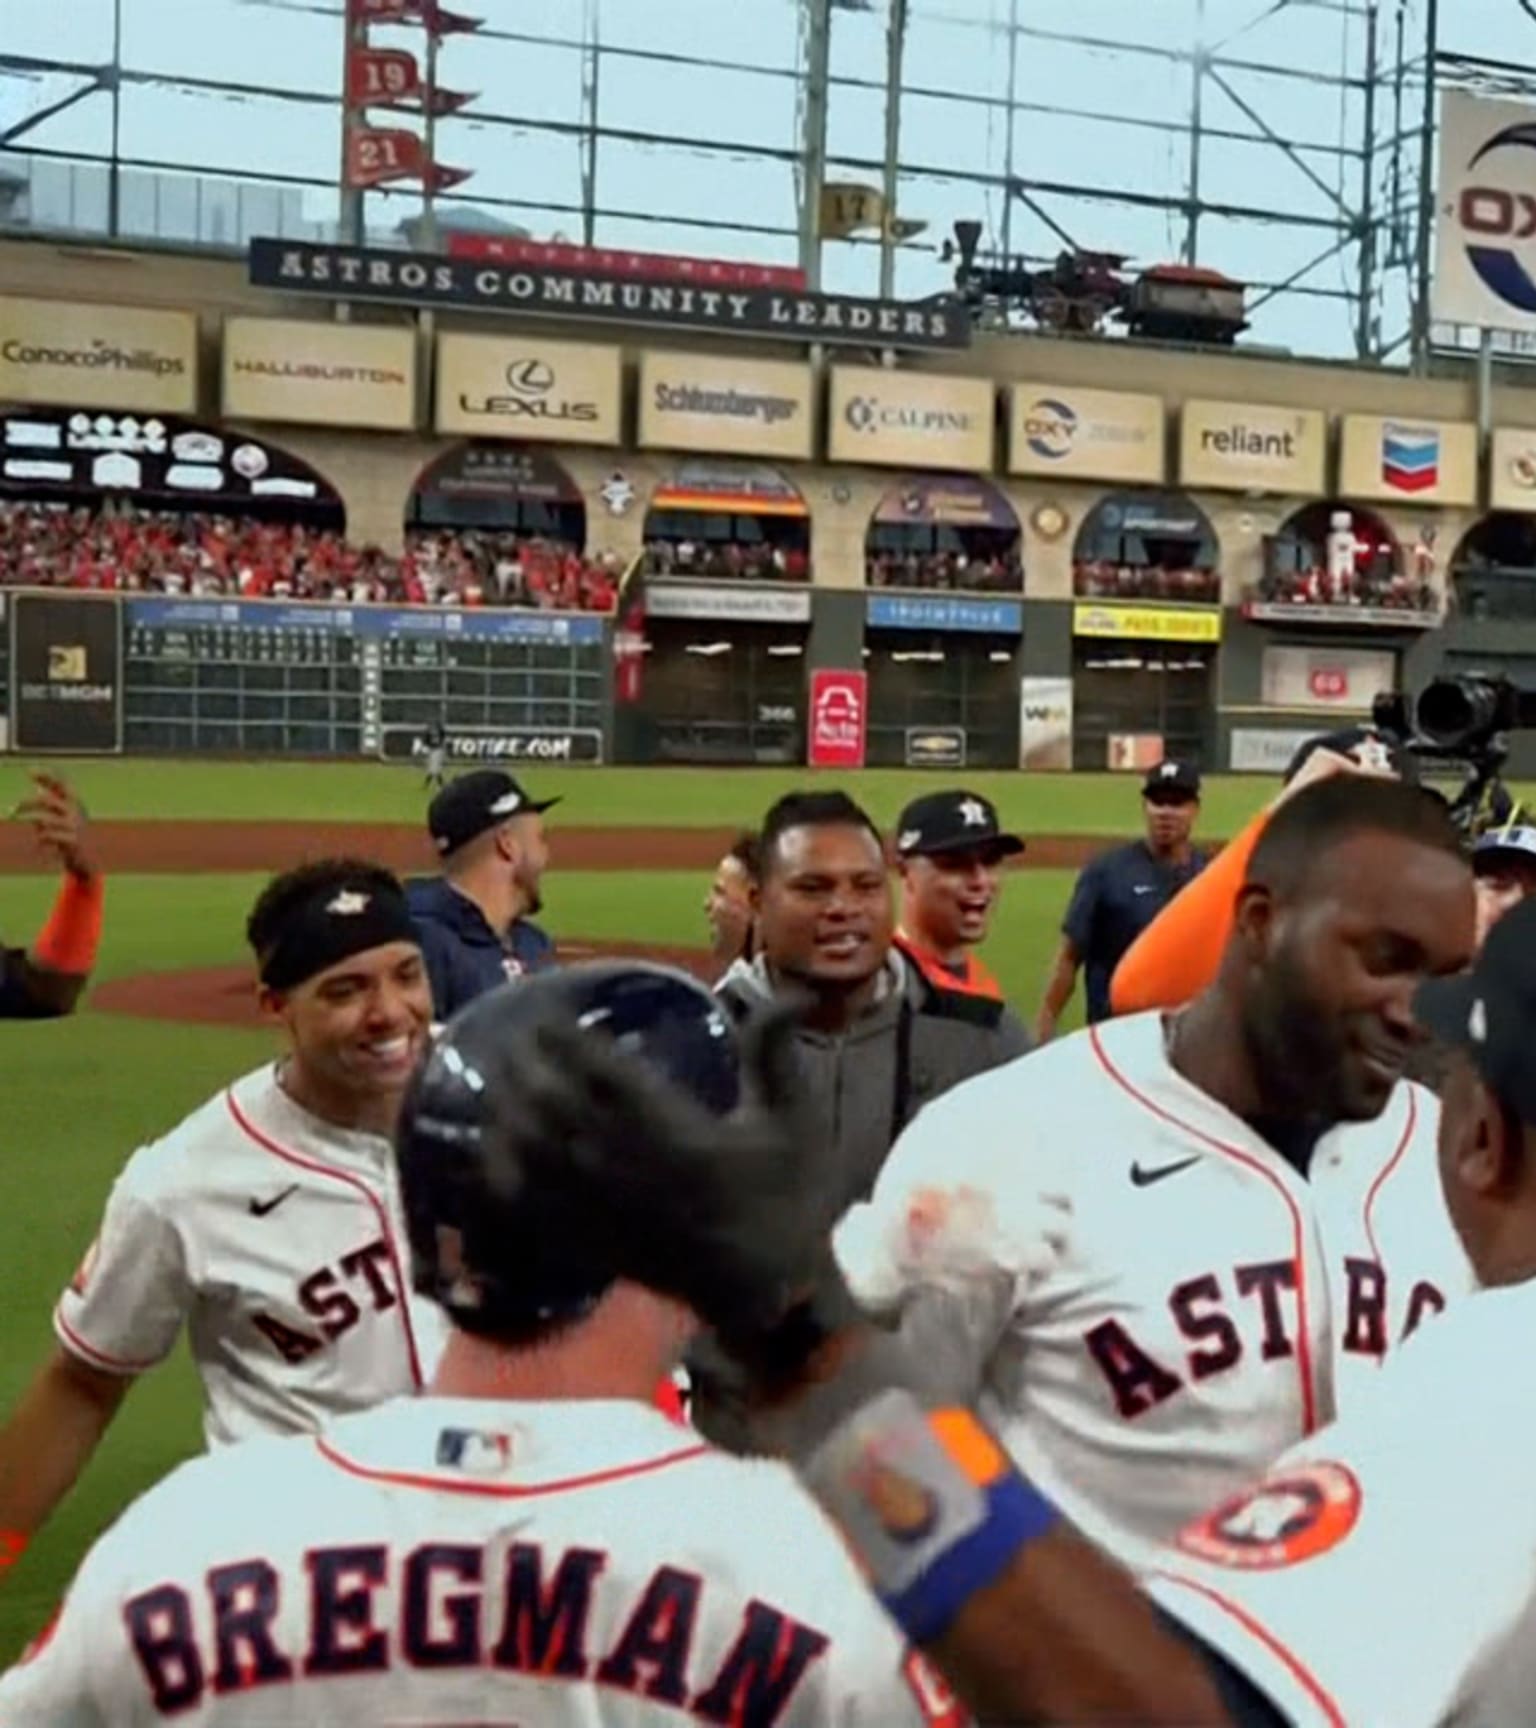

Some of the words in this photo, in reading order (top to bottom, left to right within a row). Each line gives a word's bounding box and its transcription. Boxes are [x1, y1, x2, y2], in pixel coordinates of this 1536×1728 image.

[366, 62, 406, 93] 19
[358, 138, 398, 168] 21
[279, 252, 453, 290] ASTROS
[475, 270, 749, 320] COMMUNITY
[770, 299, 947, 338] LEADERS
[2, 339, 184, 378] ConocoPhillips
[233, 358, 405, 385] HALLIBURTON
[458, 394, 599, 421] LEXUS
[1023, 418, 1077, 438] OXY
[1201, 423, 1295, 458] reliant
[122, 1542, 831, 1728] BREGMAN
